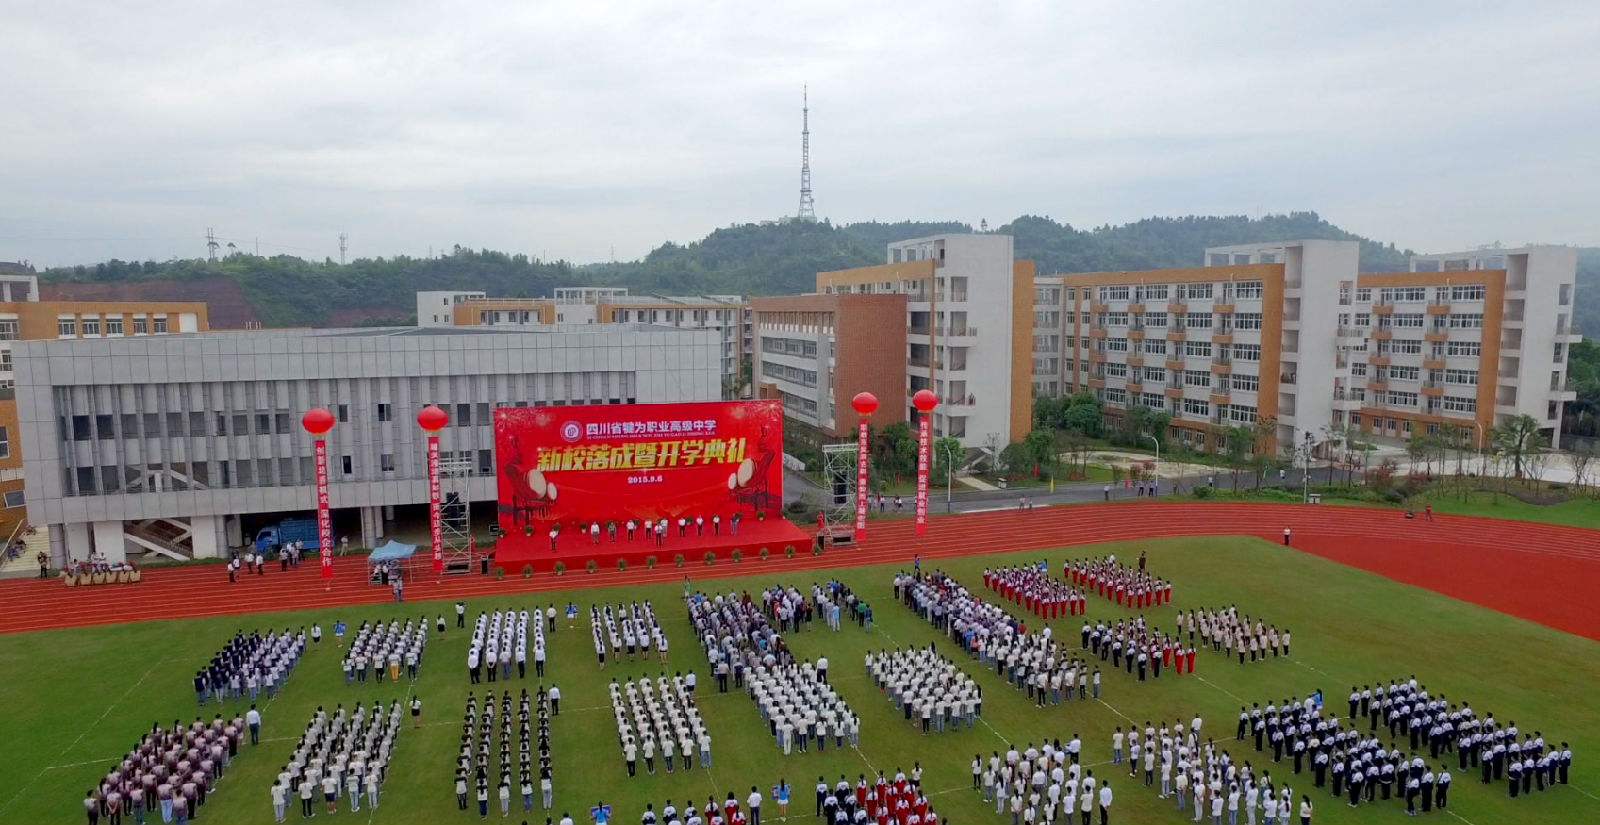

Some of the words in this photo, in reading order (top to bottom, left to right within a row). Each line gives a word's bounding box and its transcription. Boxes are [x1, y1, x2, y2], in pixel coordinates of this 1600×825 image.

[586, 420, 717, 435] 四川省犍为职业高级中学
[537, 438, 747, 472] 新校落成暨开学典礼
[320, 509, 332, 566] 深化校企合作
